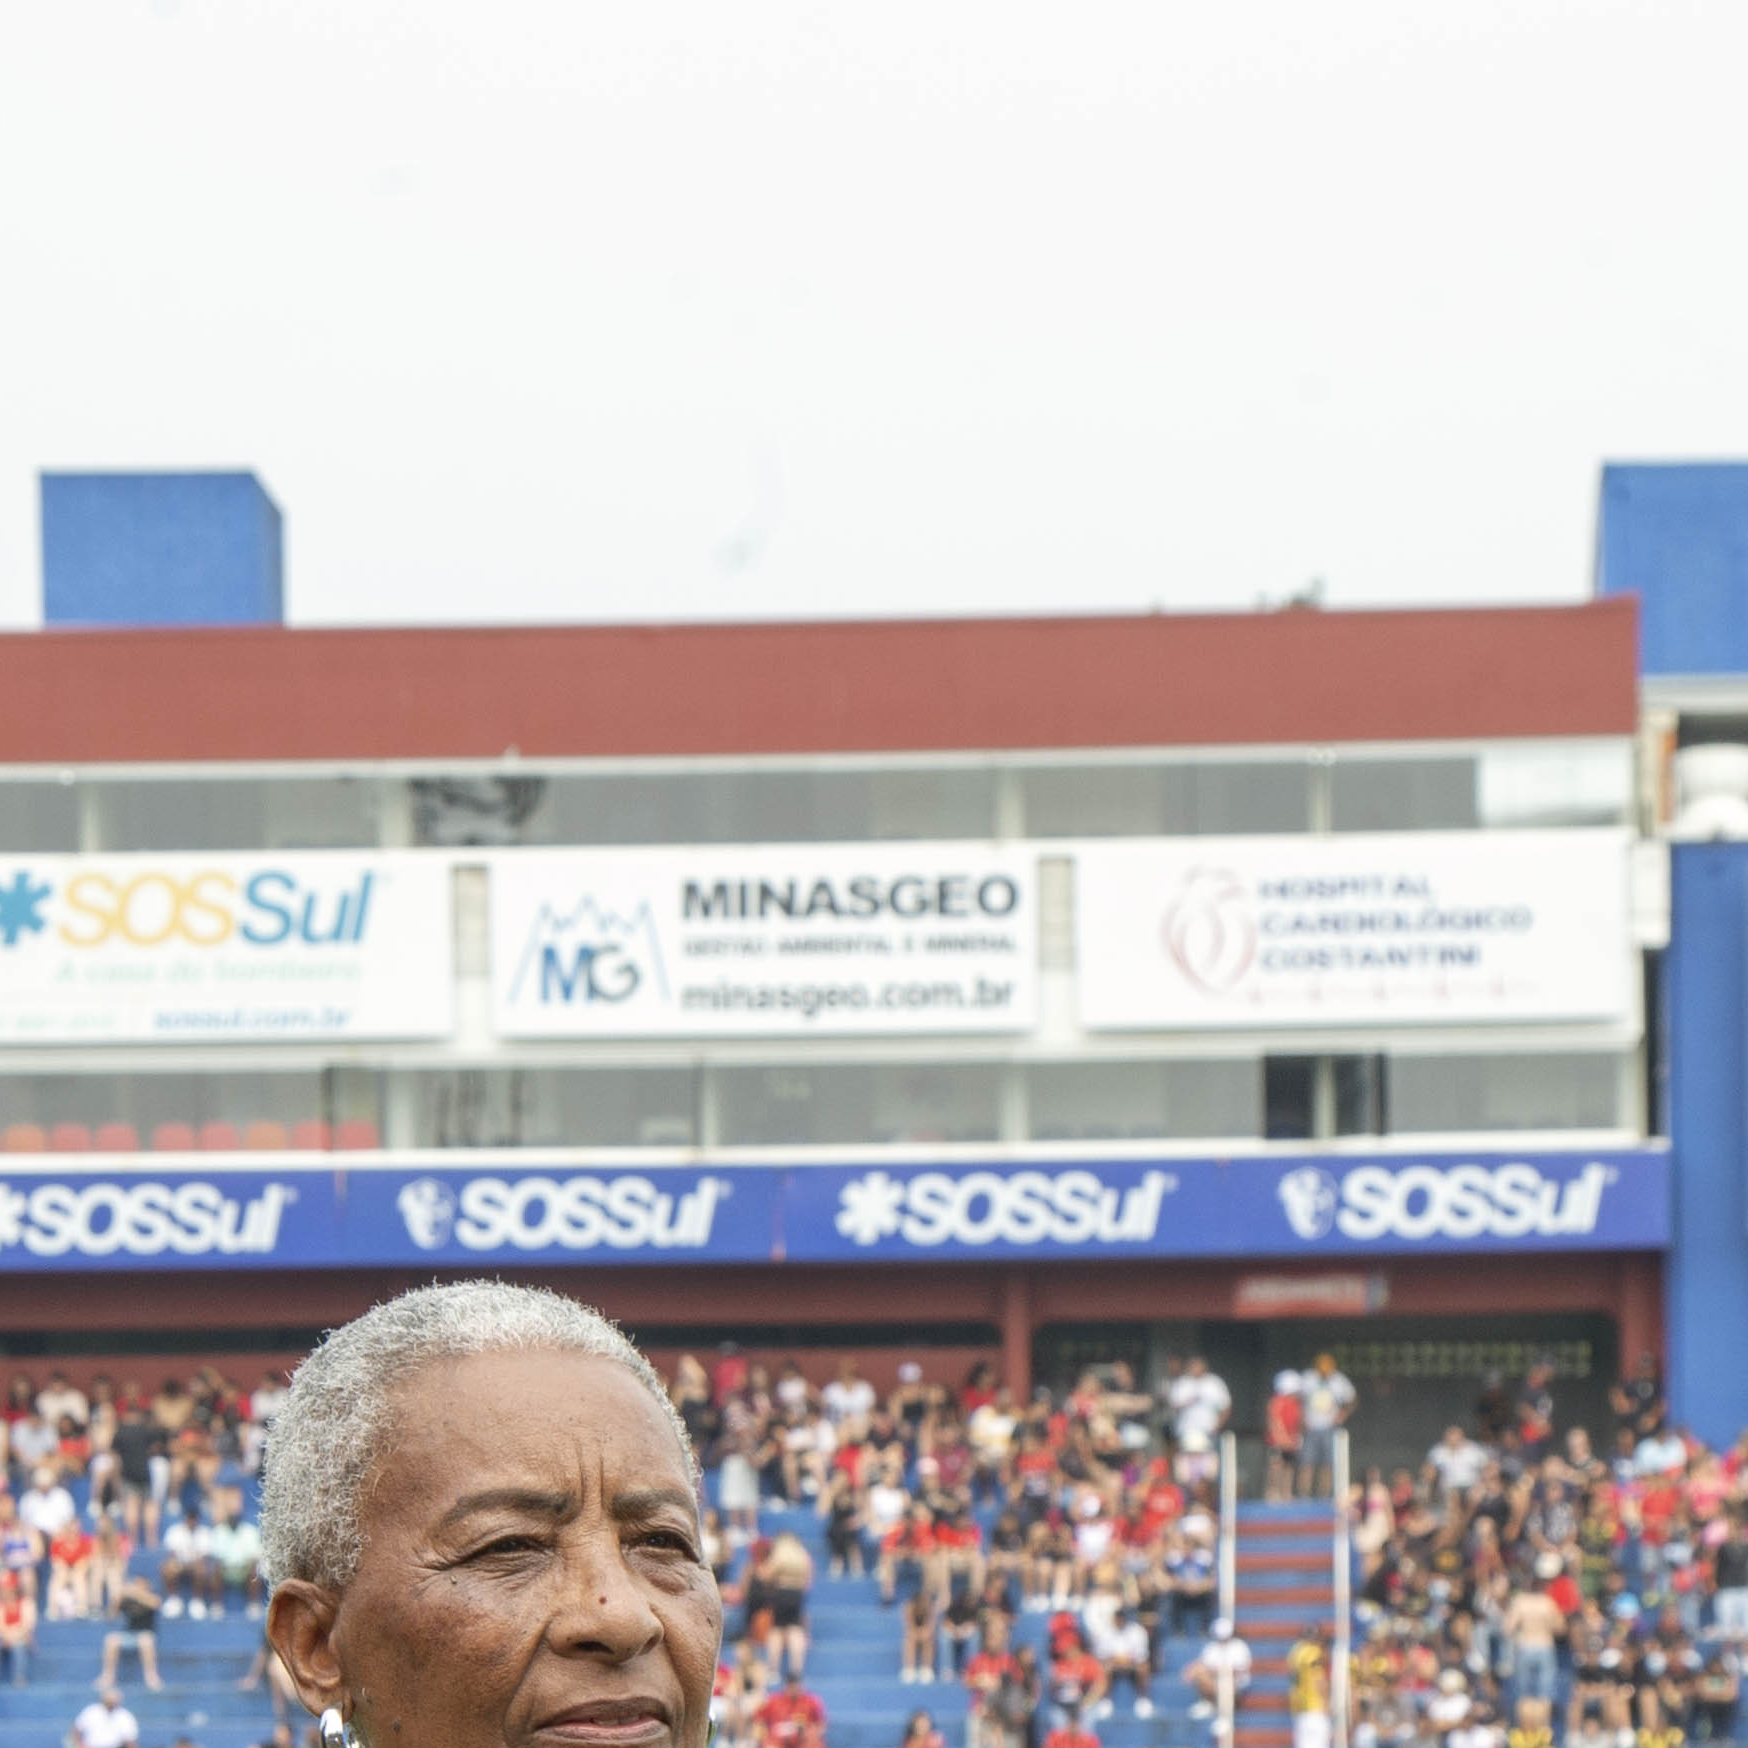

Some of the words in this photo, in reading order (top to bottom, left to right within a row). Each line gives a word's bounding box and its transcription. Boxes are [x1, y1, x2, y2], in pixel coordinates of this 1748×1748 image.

[56, 869, 377, 949] SOSSul
[681, 875, 1021, 919] MINASGEO
[1257, 873, 1431, 899] HOSPITAL
[540, 941, 641, 1004] MG
[1259, 943, 1483, 972] COSTANTINI
[681, 975, 1015, 1019] minasgeo.com.br
[22, 1180, 287, 1255] SOSSul
[454, 1175, 719, 1250] SOSSul
[900, 1168, 1166, 1246] SOSSul
[1337, 1161, 1606, 1241] SOSSul
